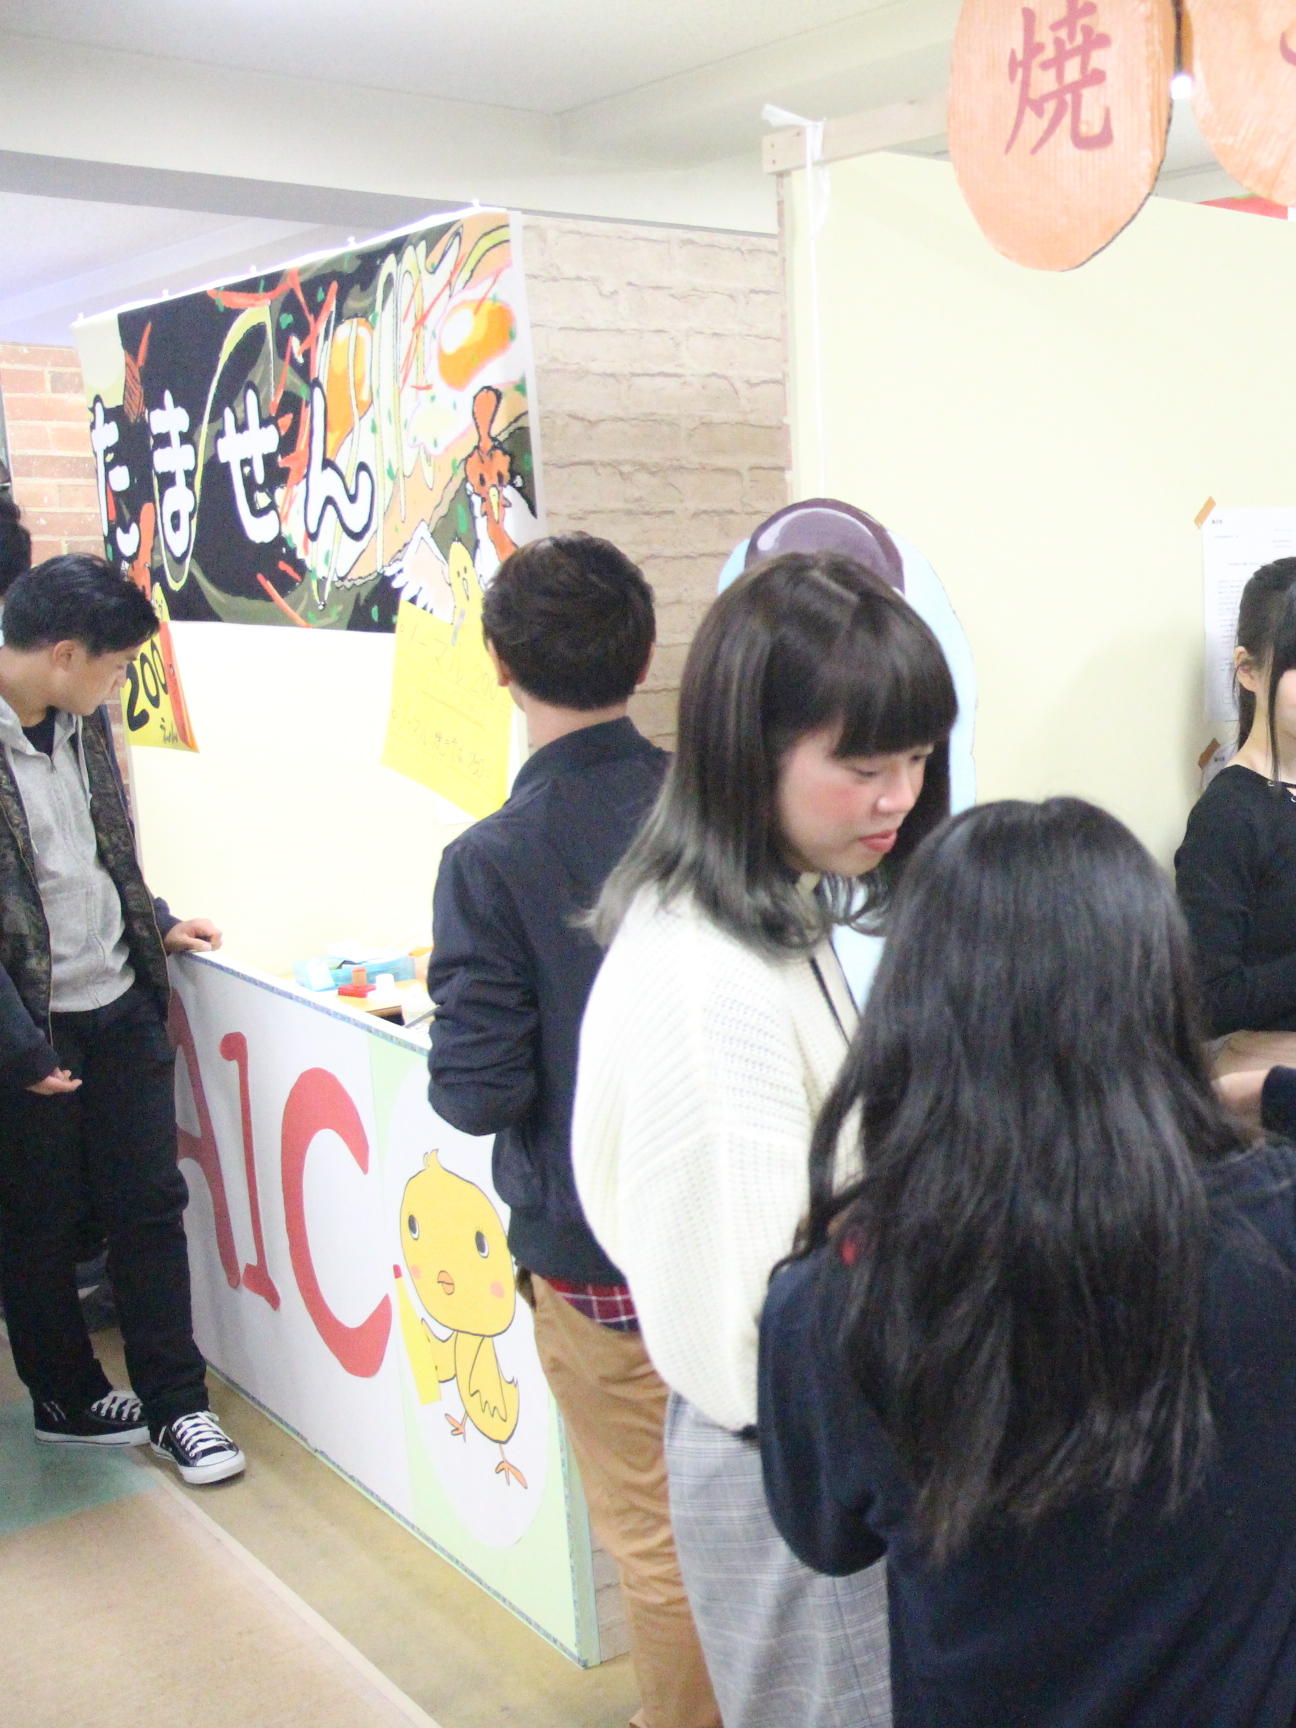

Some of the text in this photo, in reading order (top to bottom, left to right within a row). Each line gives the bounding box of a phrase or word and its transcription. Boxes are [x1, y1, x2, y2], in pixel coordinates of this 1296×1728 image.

[90, 380, 376, 559] たません
[126, 638, 169, 732] 200
